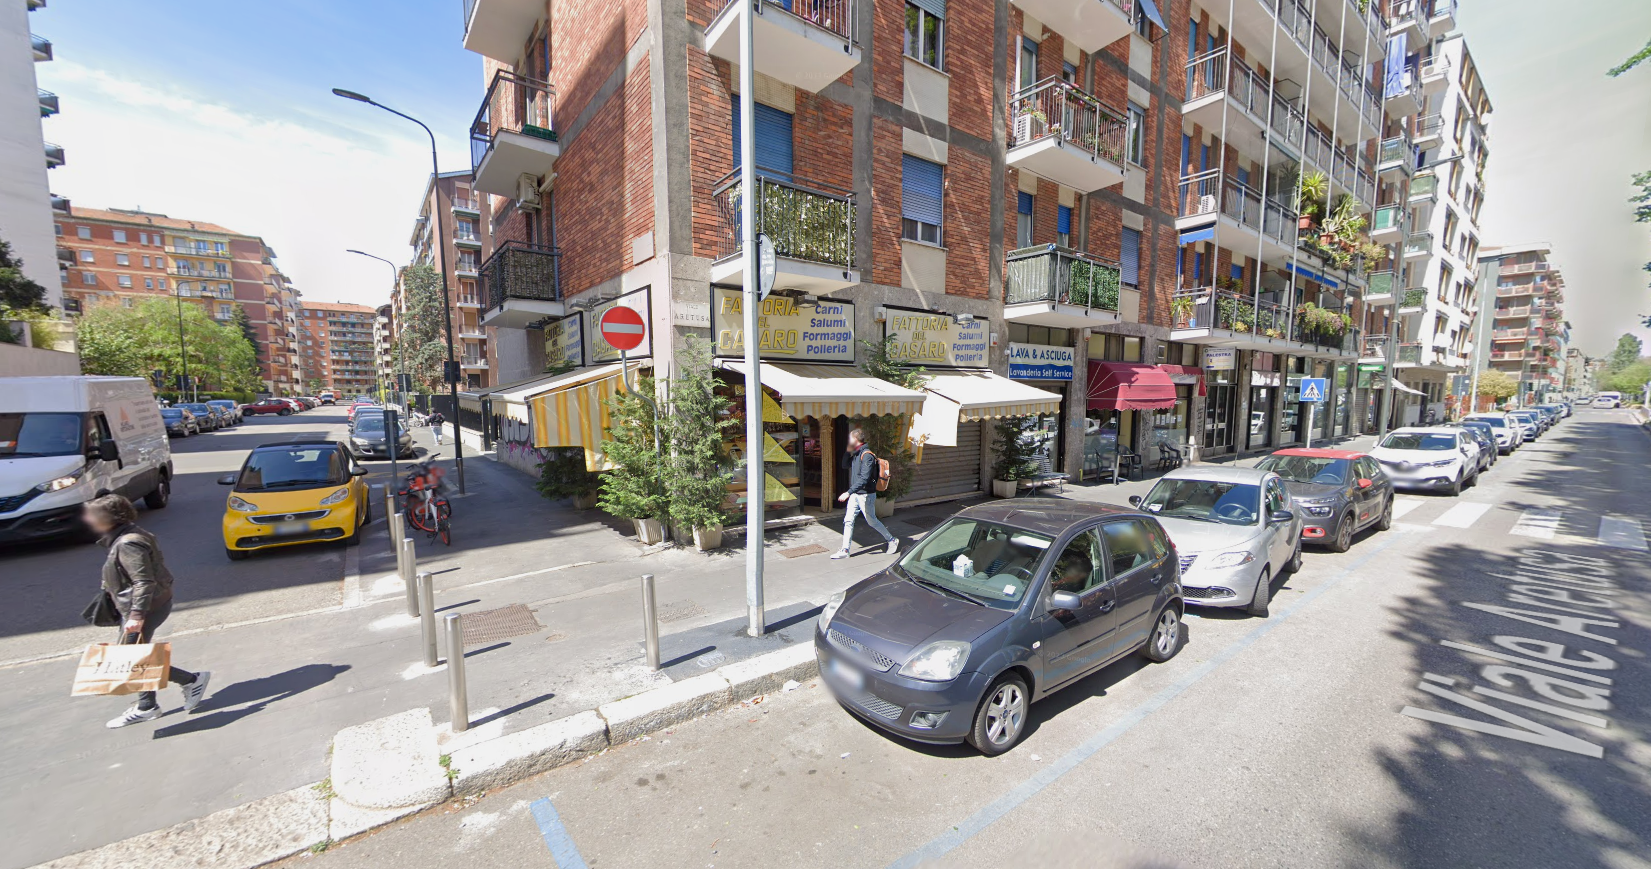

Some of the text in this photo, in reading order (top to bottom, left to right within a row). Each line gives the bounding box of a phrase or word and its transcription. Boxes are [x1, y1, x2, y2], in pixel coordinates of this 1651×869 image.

[721, 297, 800, 316] FAORIA
[815, 305, 843, 315] Carni
[674, 313, 710, 322] ARETUSA
[810, 318, 847, 328] Salumi
[892, 316, 949, 331] FATTORIA
[962, 321, 981, 330] Carni
[719, 330, 798, 350] CAARO
[803, 331, 852, 342] Formaggi
[912, 331, 927, 342] DEL
[958, 332, 983, 341] Salumi
[806, 344, 847, 354] Polleria
[890, 342, 948, 359] CASARO
[952, 343, 986, 353] Formaggi
[955, 352, 983, 362] Polleria
[1010, 346, 1073, 362] LAVA & ASCIUGA
[1009, 367, 1073, 378] Lavanderia Self Service
[1460, 549, 1620, 645] Aretusa
[1400, 635, 1618, 758] Viale
